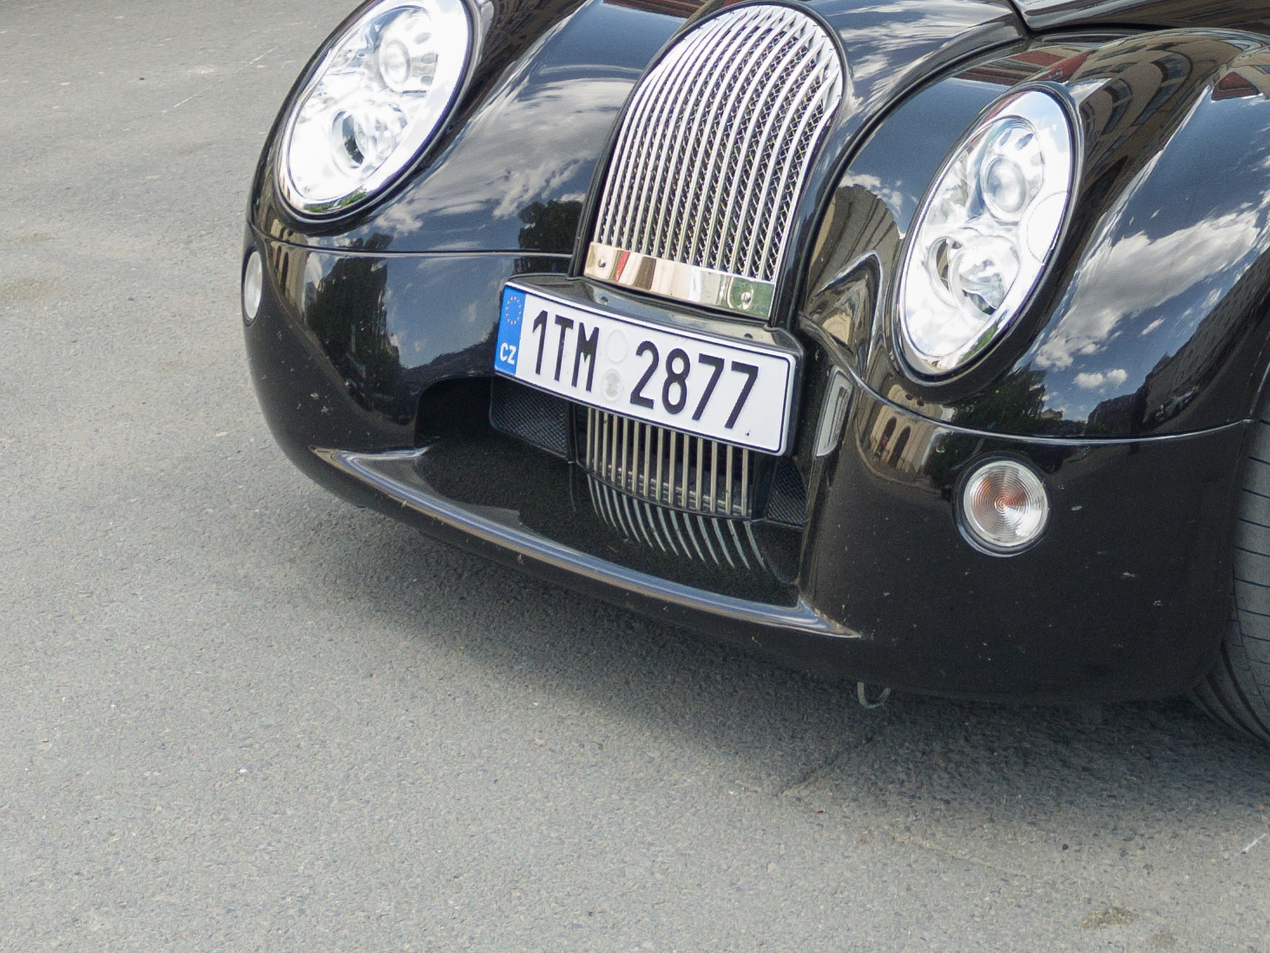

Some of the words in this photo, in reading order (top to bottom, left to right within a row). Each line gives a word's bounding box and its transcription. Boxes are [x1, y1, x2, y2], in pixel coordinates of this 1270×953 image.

[499, 342, 517, 366] CZ
[531, 309, 600, 393] 1TM
[629, 340, 760, 429] 2877
